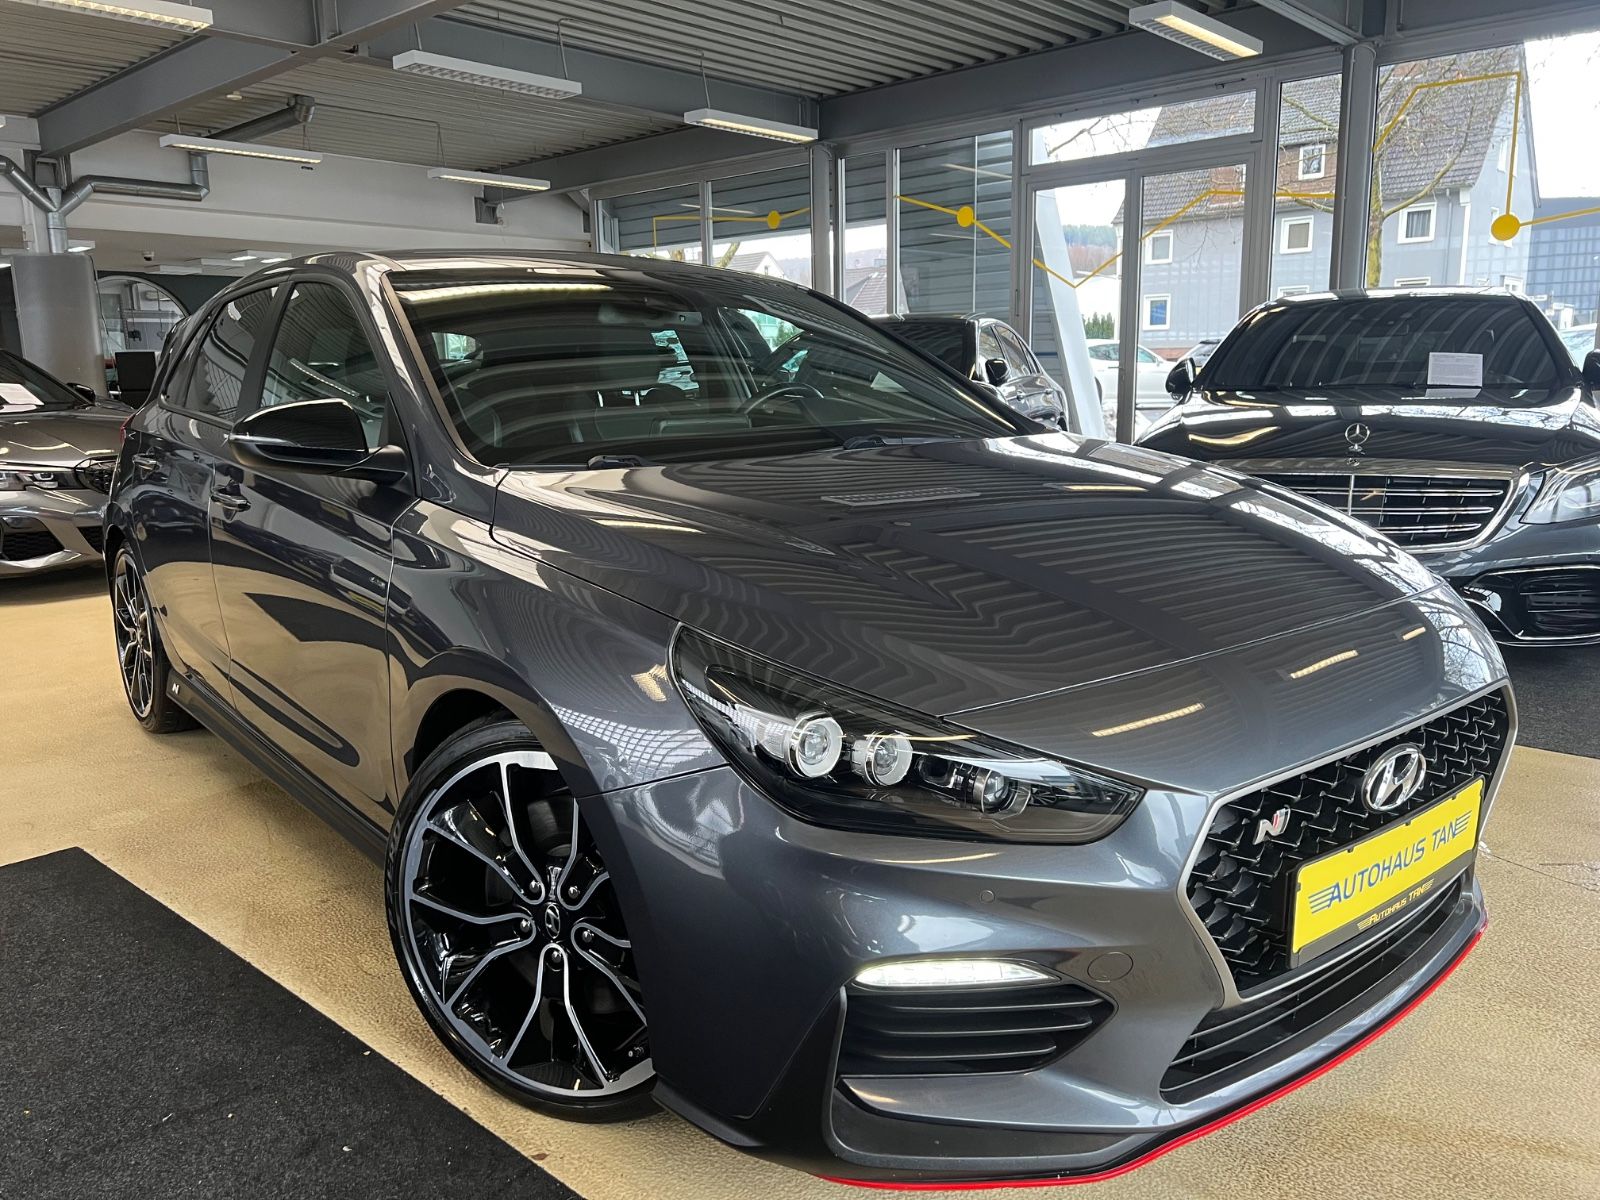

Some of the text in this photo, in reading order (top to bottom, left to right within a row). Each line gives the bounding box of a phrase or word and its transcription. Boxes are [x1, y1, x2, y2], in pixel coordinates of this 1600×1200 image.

[1327, 817, 1459, 908] AUTOHAUS TAN
[1368, 899, 1407, 924] AUTOHAUS
